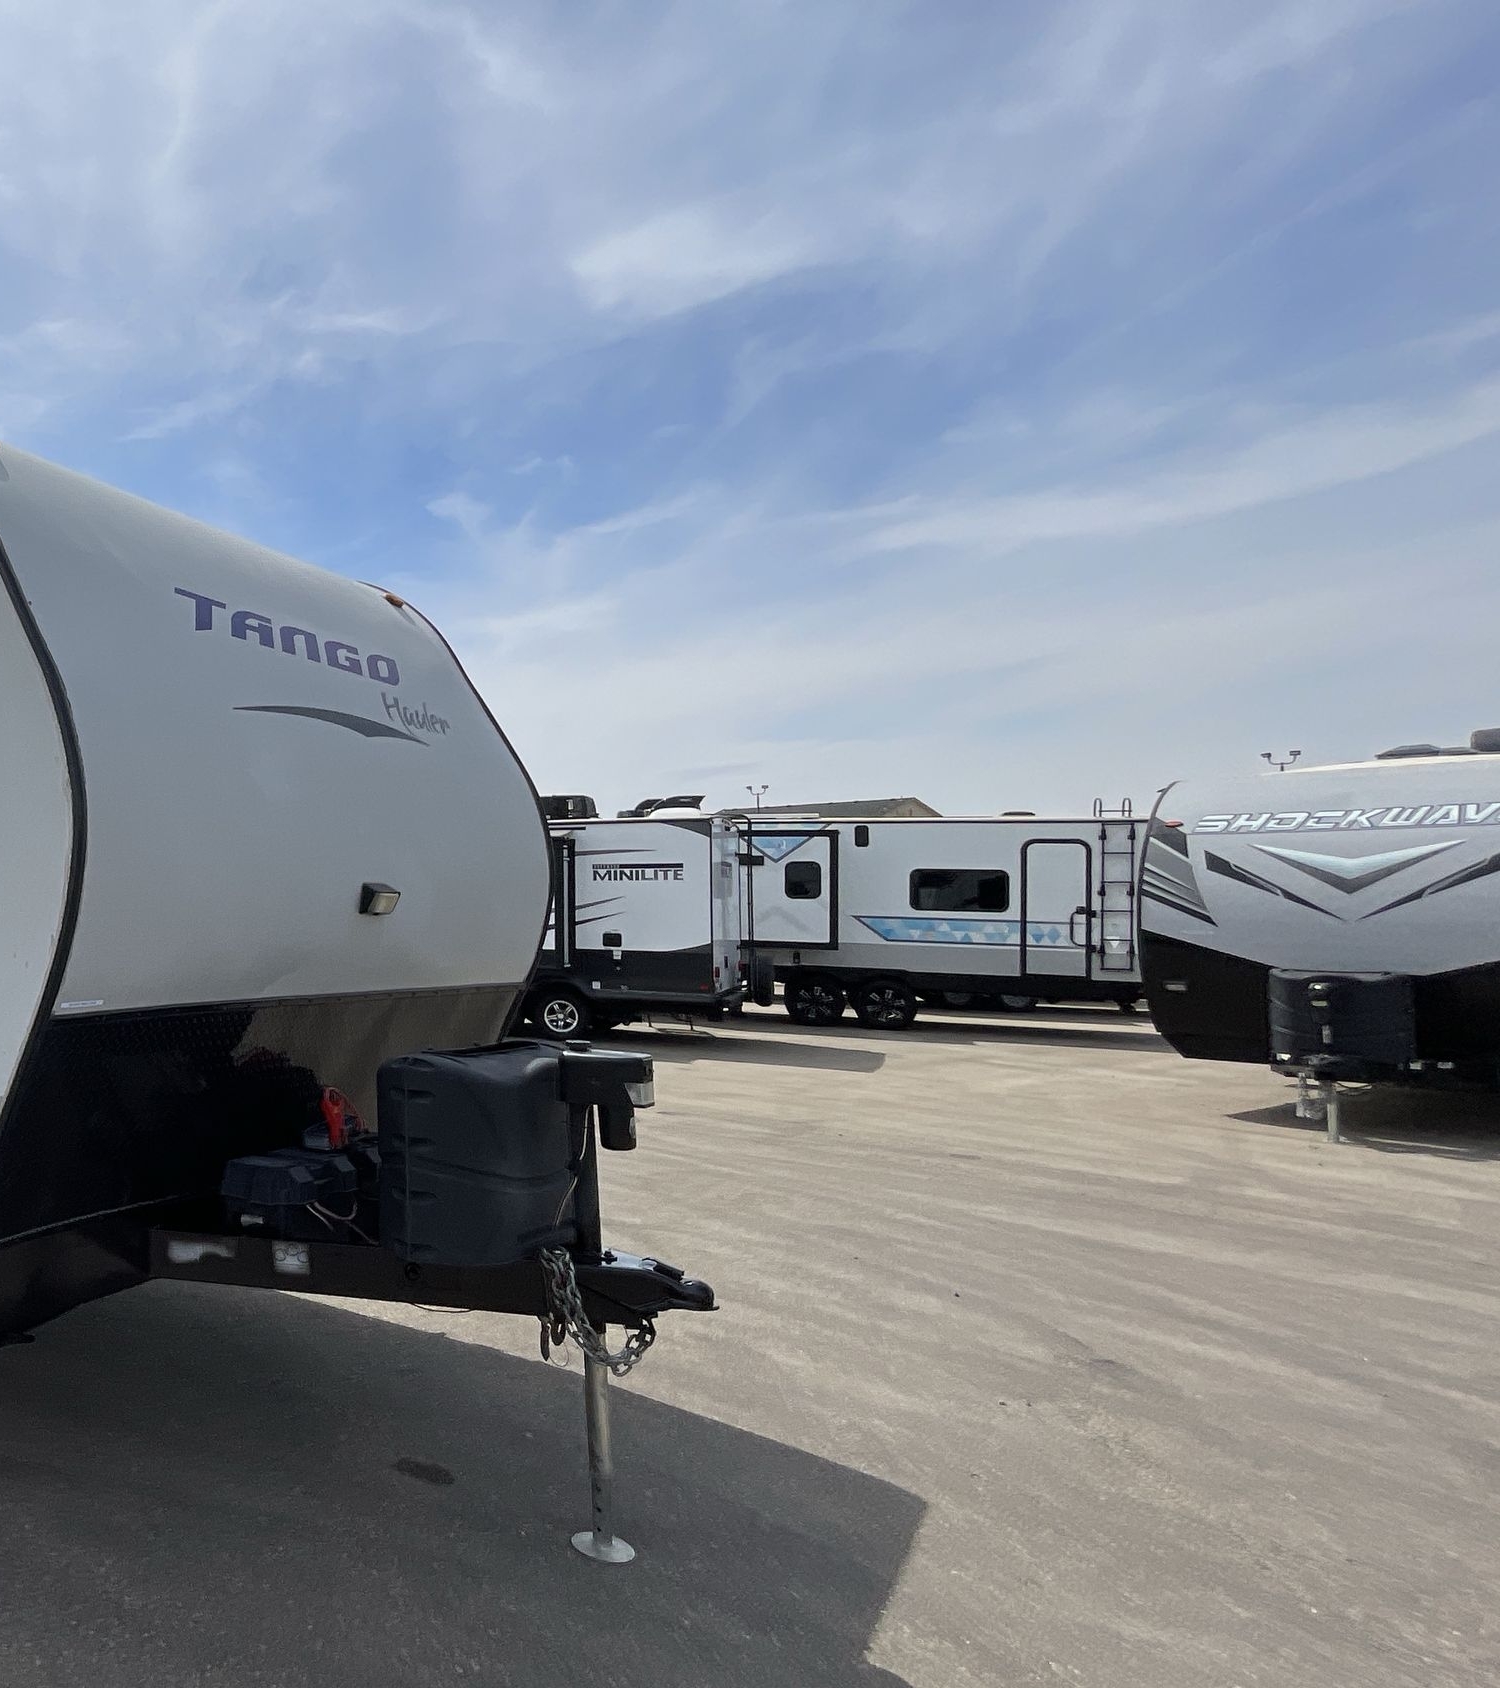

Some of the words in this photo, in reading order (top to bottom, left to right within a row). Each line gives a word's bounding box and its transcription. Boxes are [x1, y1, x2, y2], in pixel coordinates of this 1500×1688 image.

[174, 587, 400, 687] TANGO
[380, 691, 451, 739] Hauler
[1193, 801, 1500, 833] SHOCKWAV
[592, 869, 684, 881] MINILITE
